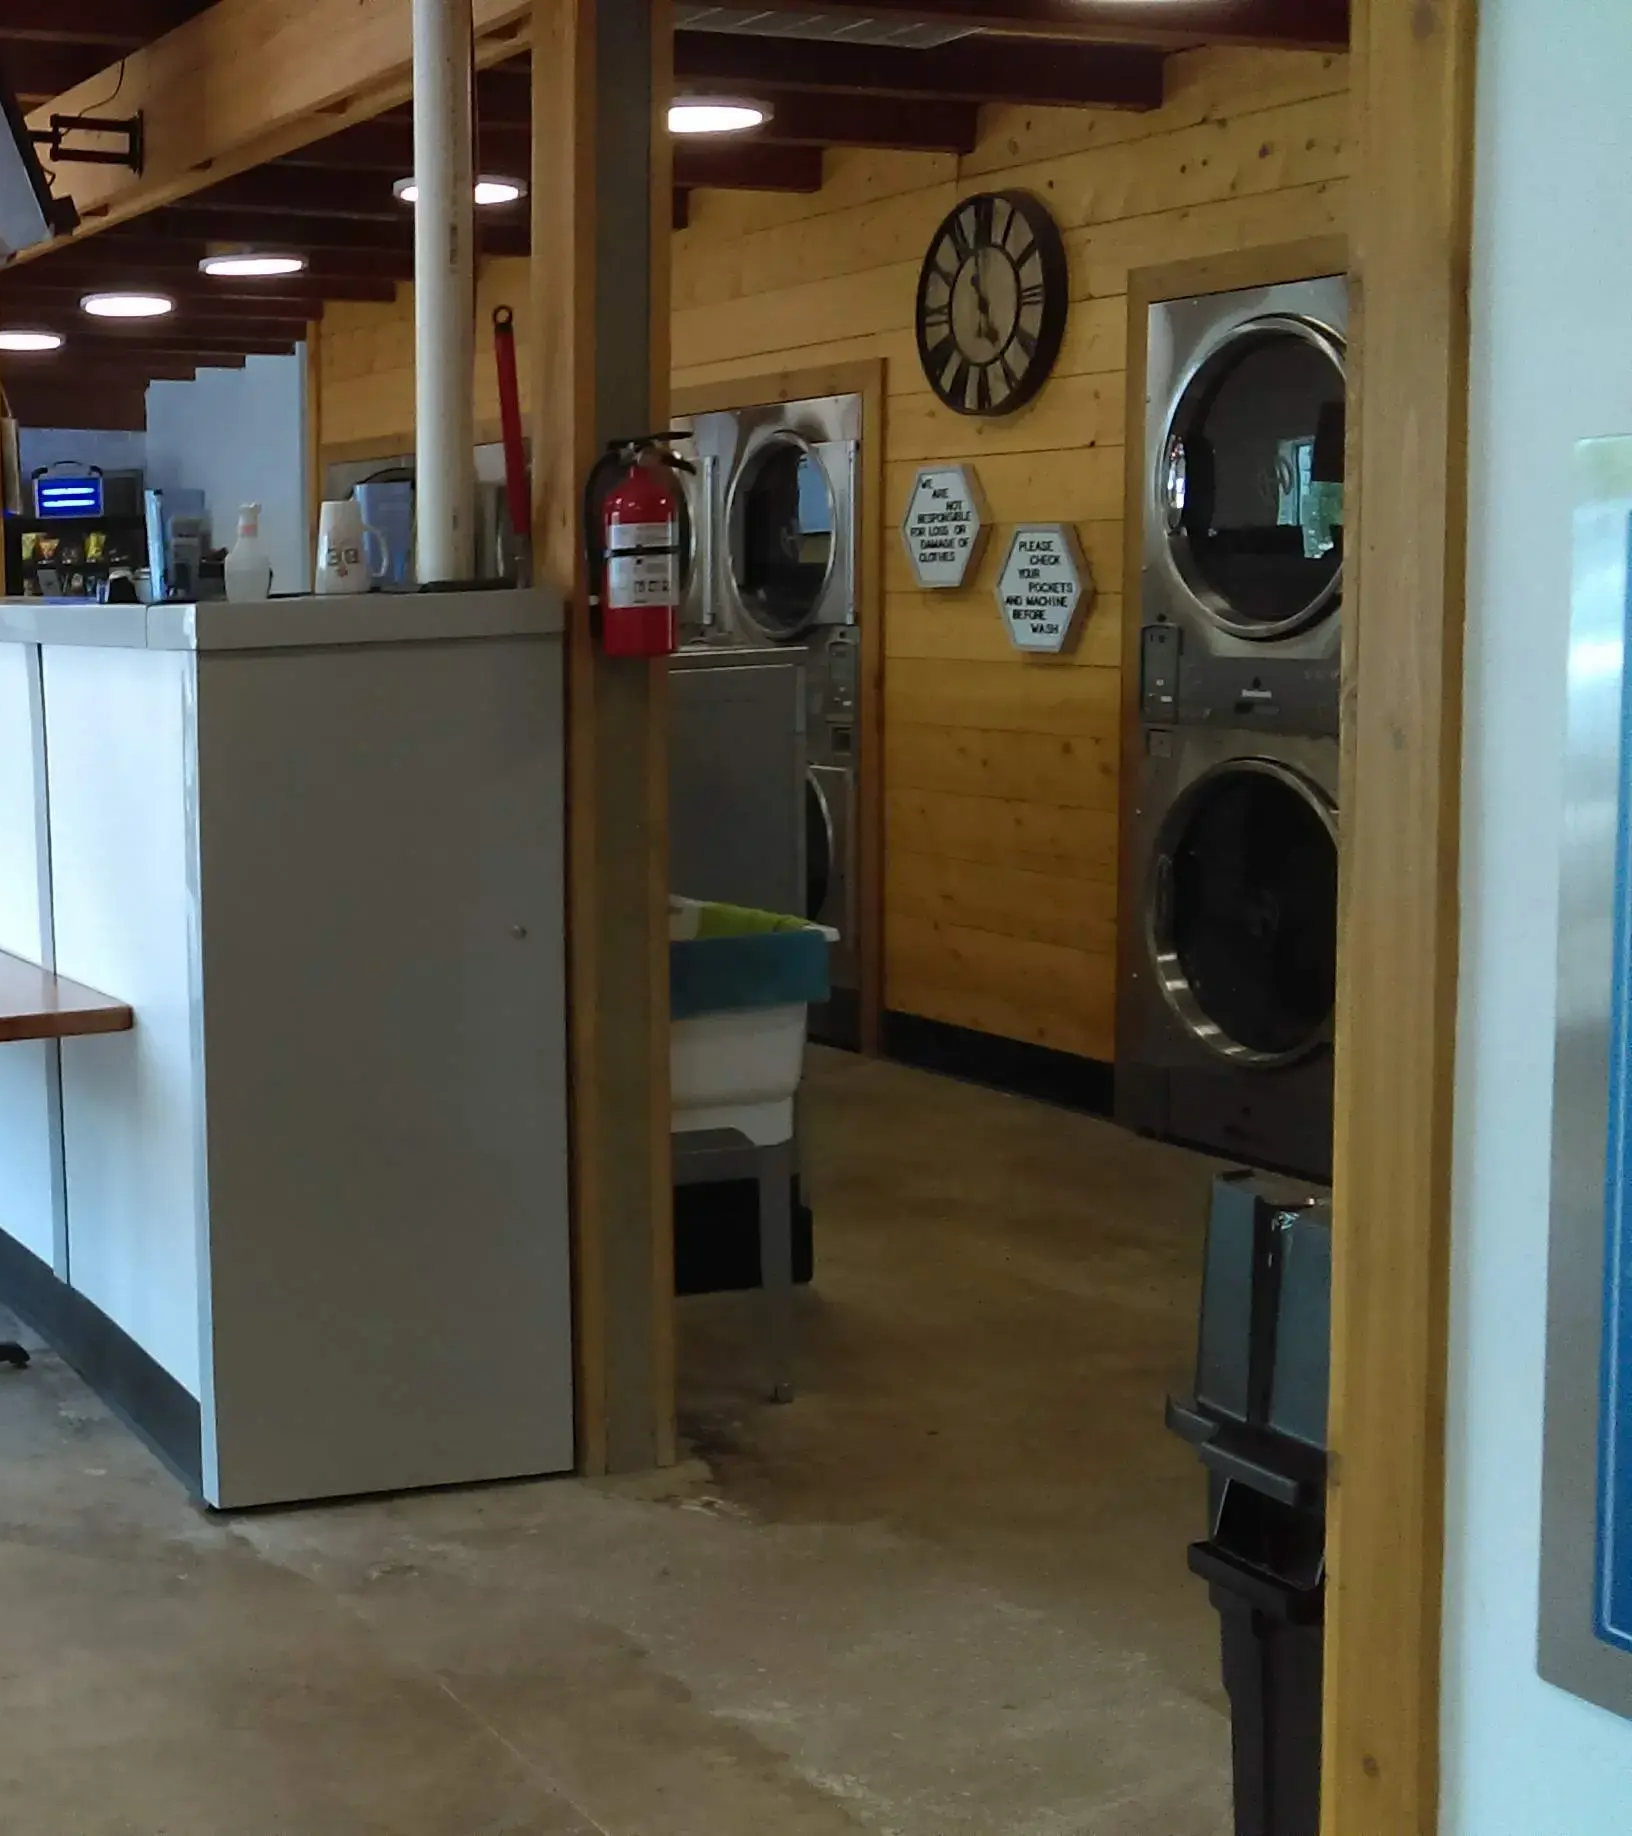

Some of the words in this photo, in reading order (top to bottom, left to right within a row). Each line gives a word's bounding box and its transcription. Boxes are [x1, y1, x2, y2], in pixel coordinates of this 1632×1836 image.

[921, 478, 933, 489] WE
[932, 487, 950, 498] ARE
[945, 500, 962, 511] NOT
[910, 527, 926, 537] FOR
[928, 525, 949, 536] LOSS
[953, 524, 967, 535] OR
[958, 536, 971, 548] OF
[1018, 540, 1055, 552] PLEASE
[919, 551, 956, 562] CLOTHES
[1029, 554, 1061, 565] CHECK
[1017, 568, 1041, 579] YOUR
[1028, 581, 1073, 594] POCKETS
[1005, 595, 1023, 606] AND
[1026, 595, 1068, 608] MACHINE
[1012, 608, 1047, 621] BEFORE
[1030, 622, 1060, 634] WASH
